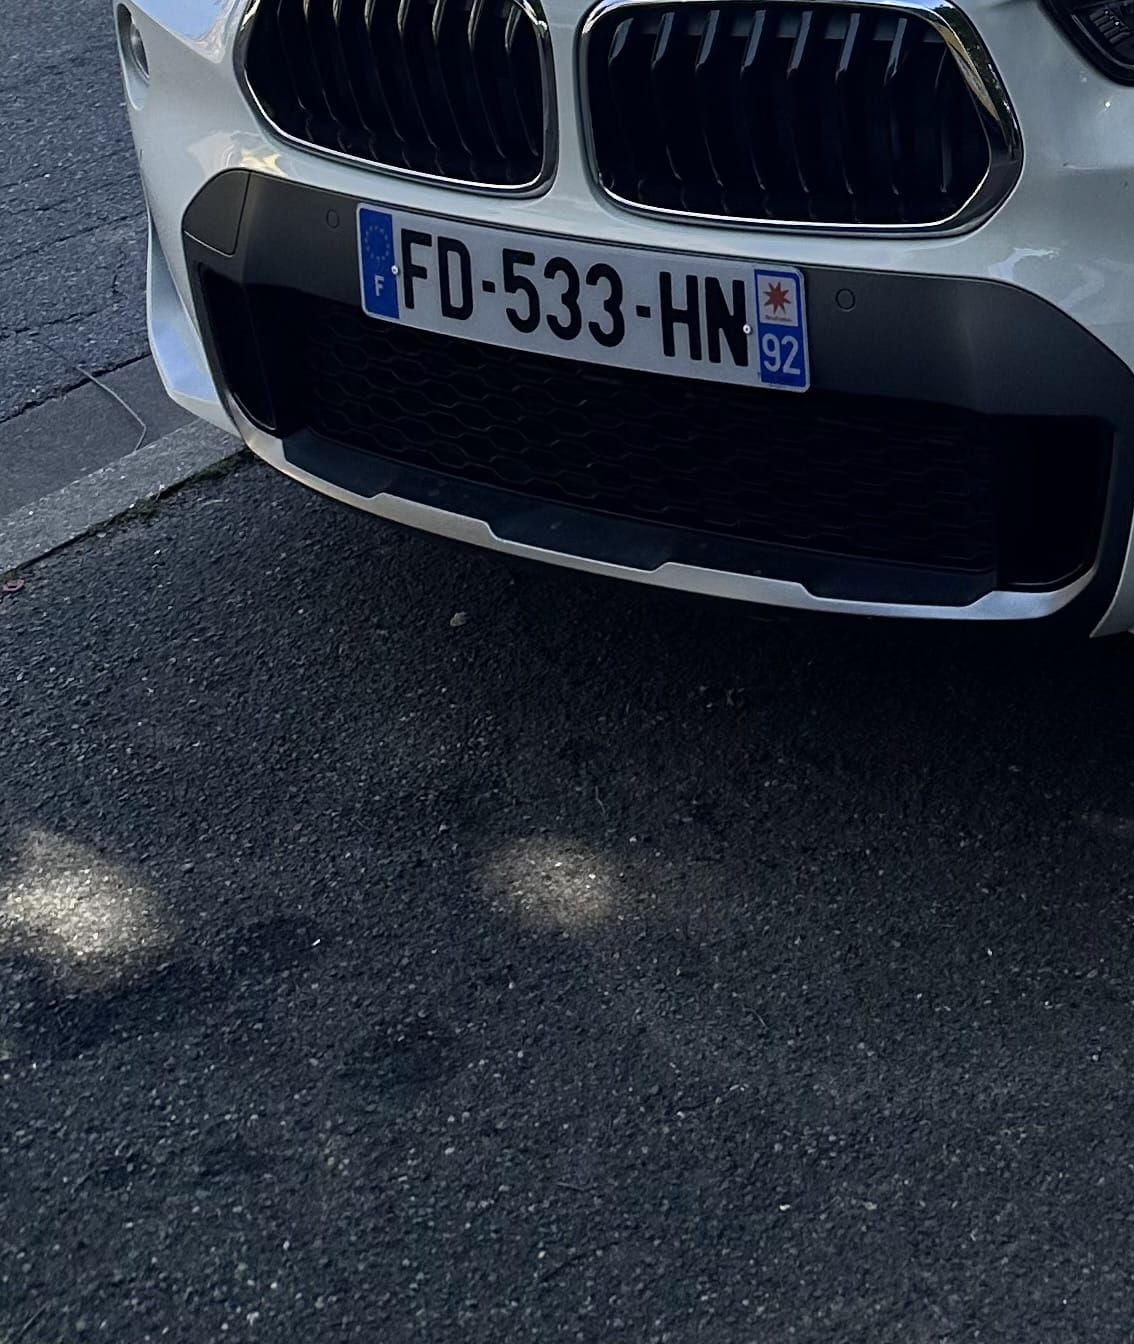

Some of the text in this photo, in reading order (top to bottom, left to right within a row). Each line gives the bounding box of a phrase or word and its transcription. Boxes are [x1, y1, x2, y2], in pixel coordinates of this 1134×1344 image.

[374, 275, 385, 297] F
[400, 228, 749, 367] FD-533-HN
[762, 333, 800, 375] 92
